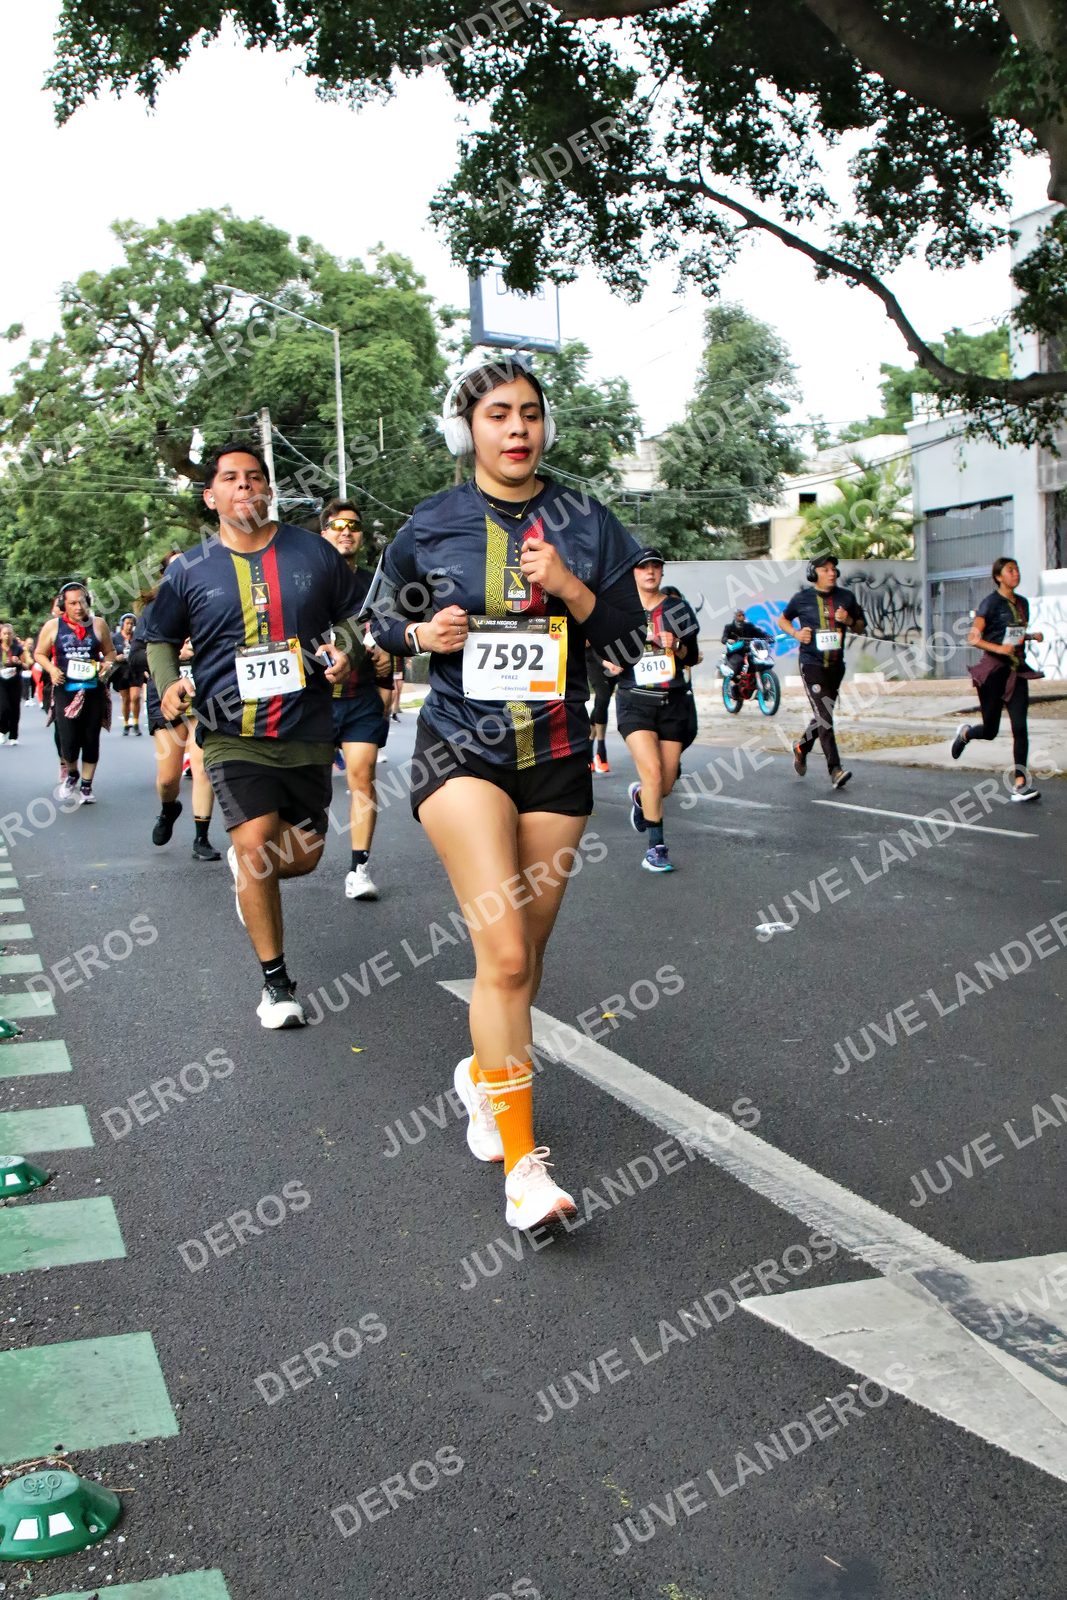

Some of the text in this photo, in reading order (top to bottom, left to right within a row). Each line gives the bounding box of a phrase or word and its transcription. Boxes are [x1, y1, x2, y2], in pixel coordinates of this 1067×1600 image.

[551, 623, 562, 632] 5K
[477, 643, 544, 671] 7592
[73, 663, 90, 673] 1136
[246, 658, 290, 680] 3718
[641, 660, 666, 672] 3610
